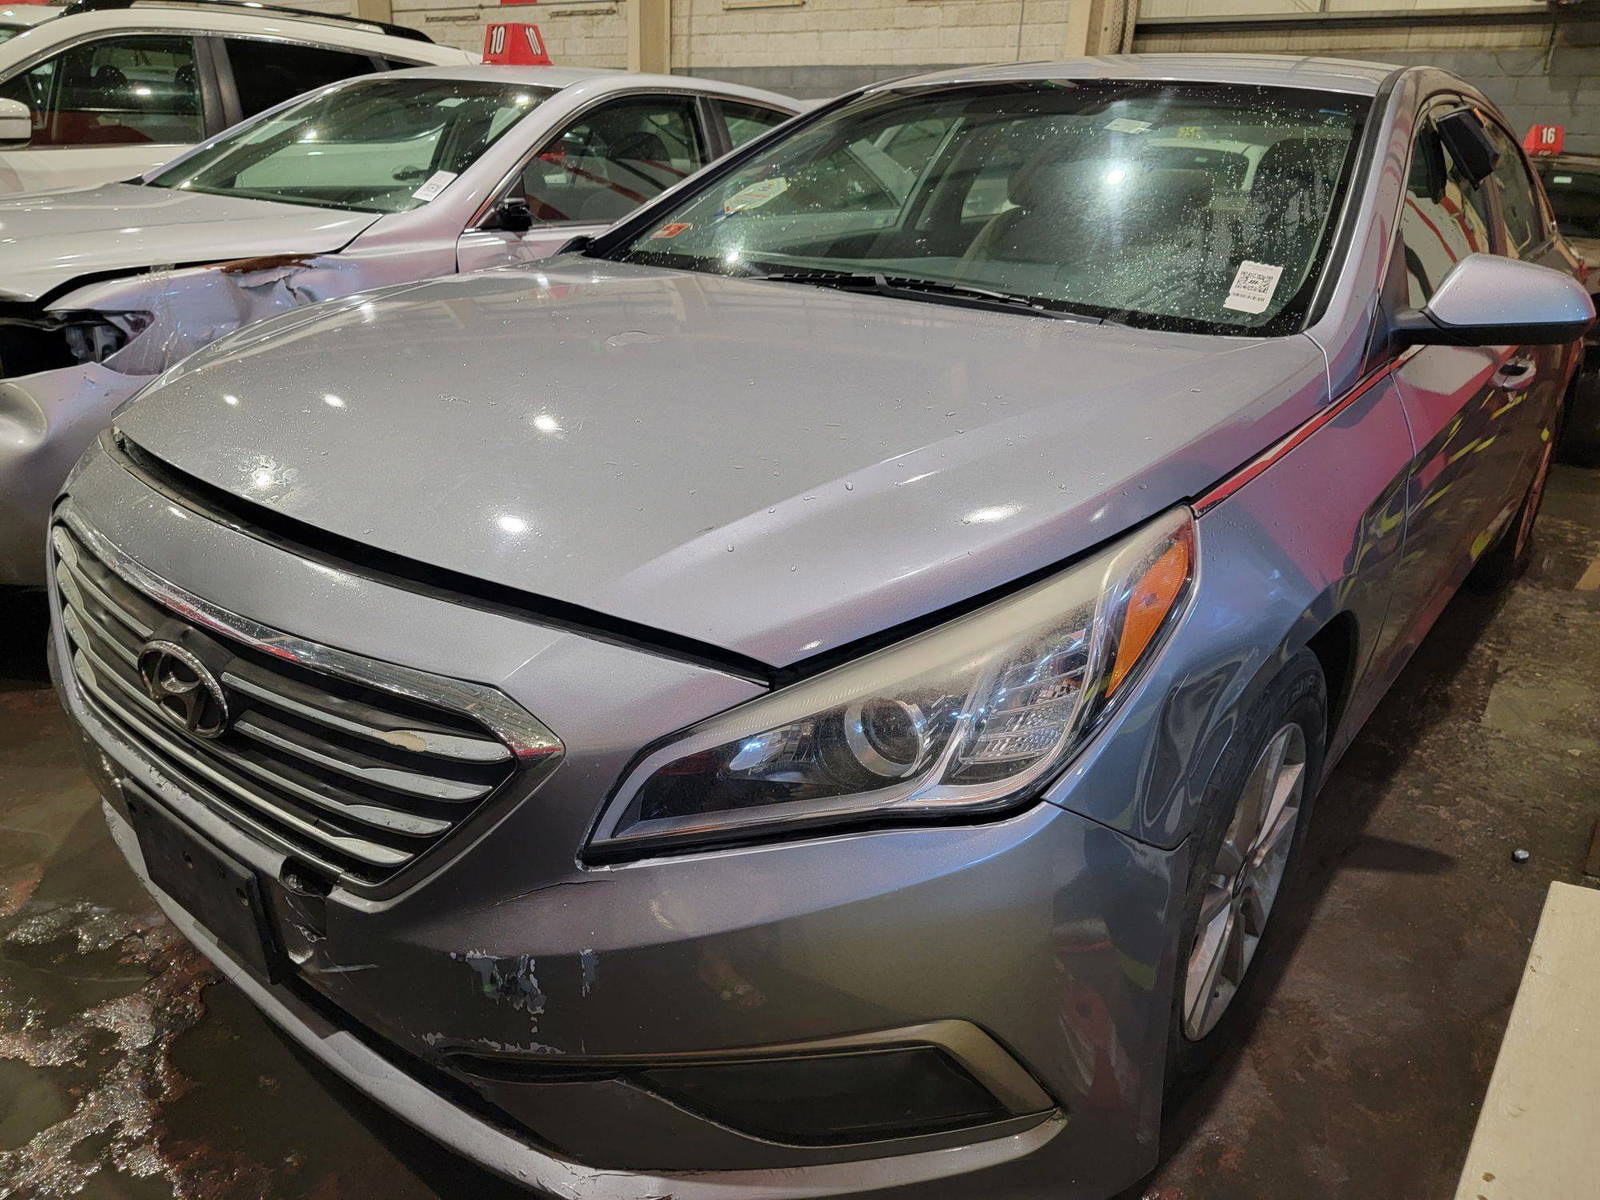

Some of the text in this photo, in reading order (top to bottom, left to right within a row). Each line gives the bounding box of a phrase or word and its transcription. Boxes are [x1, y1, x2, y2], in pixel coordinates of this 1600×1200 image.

[490, 26, 505, 54] 10
[525, 27, 542, 55] 10
[1541, 127, 1556, 144] 16
